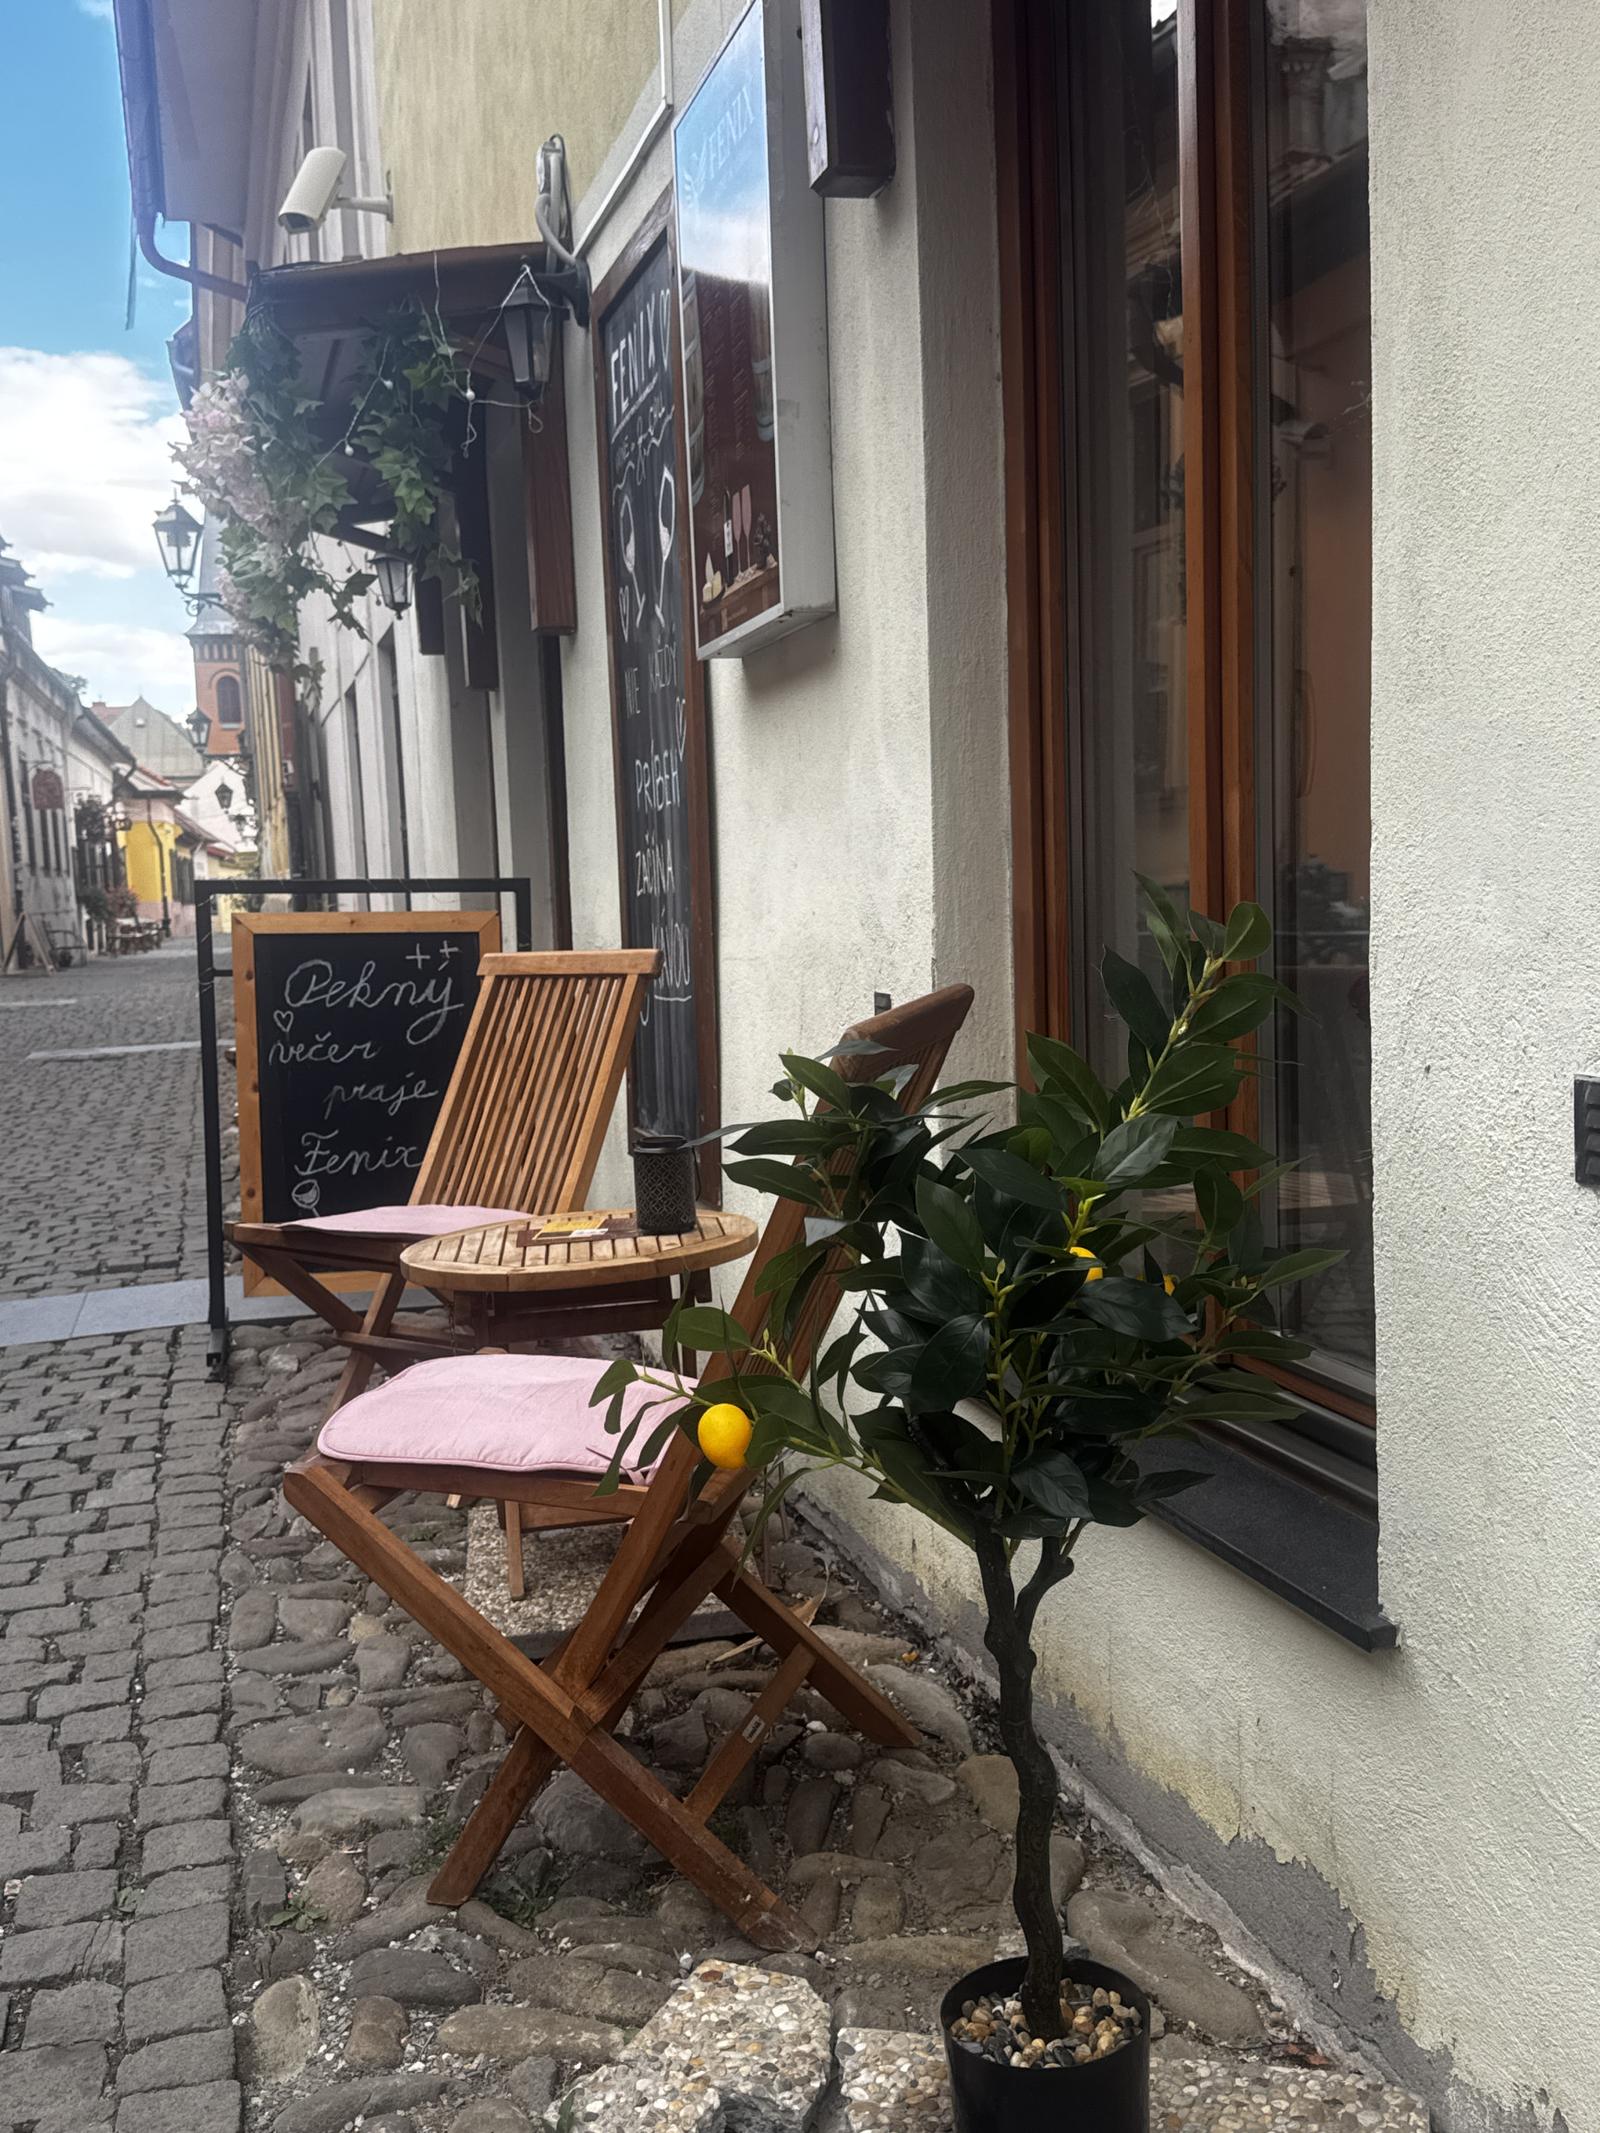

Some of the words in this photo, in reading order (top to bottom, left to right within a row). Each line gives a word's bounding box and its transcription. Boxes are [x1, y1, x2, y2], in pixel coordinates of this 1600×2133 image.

[610, 292, 656, 427] FENIX
[635, 740, 681, 815] PRÍBEH
[635, 831, 676, 896] ZAČÍNA
[284, 957, 464, 1045] Pekný
[268, 1031, 377, 1065] večer
[294, 1129, 424, 1176] Fenix
